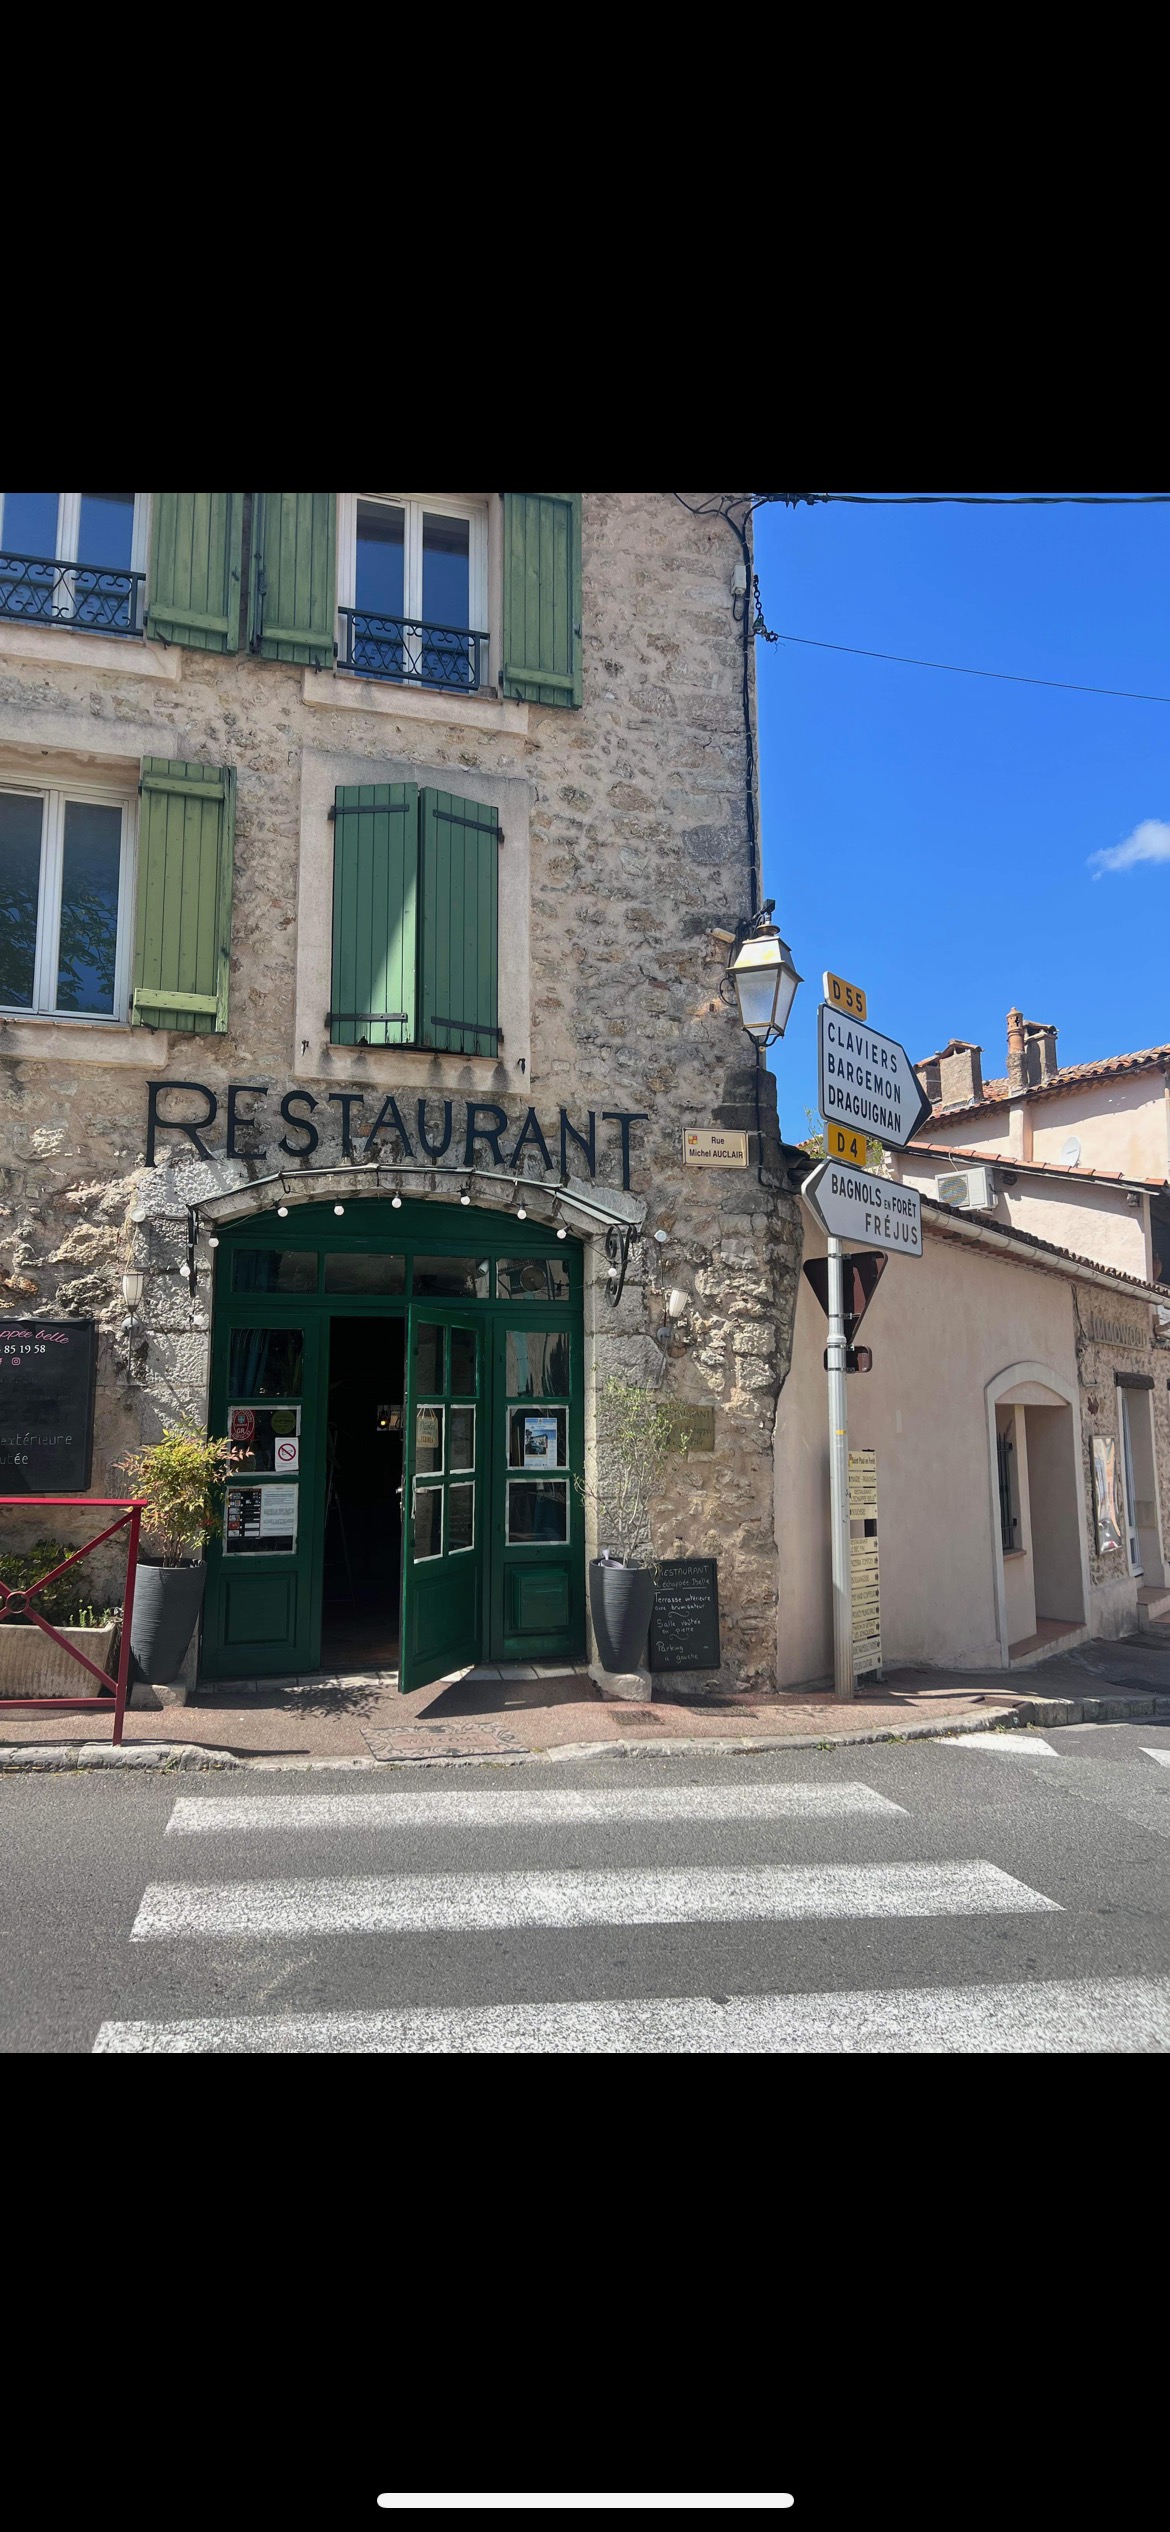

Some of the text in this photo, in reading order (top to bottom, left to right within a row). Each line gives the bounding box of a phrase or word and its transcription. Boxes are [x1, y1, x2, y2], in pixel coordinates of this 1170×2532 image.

[833, 980, 863, 1013] D 55
[828, 1022, 898, 1073] CLAVIERS
[828, 1053, 901, 1104] BARGEMON
[828, 1084, 901, 1133] DRAGUIGNAN
[144, 1080, 650, 1191] RESTAURANT
[711, 1136, 725, 1144] Rue
[837, 1132, 858, 1157] D 4
[689, 1149, 743, 1159] Michel AUCLAIR
[831, 1173, 917, 1218] BAGNOLS EN FORÊT
[865, 1213, 918, 1245] FRÉJUS
[35, 1330, 69, 1344] belle
[4, 1344, 46, 1354] 85 19 58
[1, 1432, 73, 1446] extérieure
[658, 1565, 709, 1578] RESTAURANT
[654, 1591, 682, 1603] Terrasse
[656, 1618, 676, 1628] Salle
[675, 1626, 694, 1635] pierre
[655, 1640, 684, 1653] Parking
[676, 1654, 699, 1664] gauche
[405, 1736, 481, 1745] WELCOME
